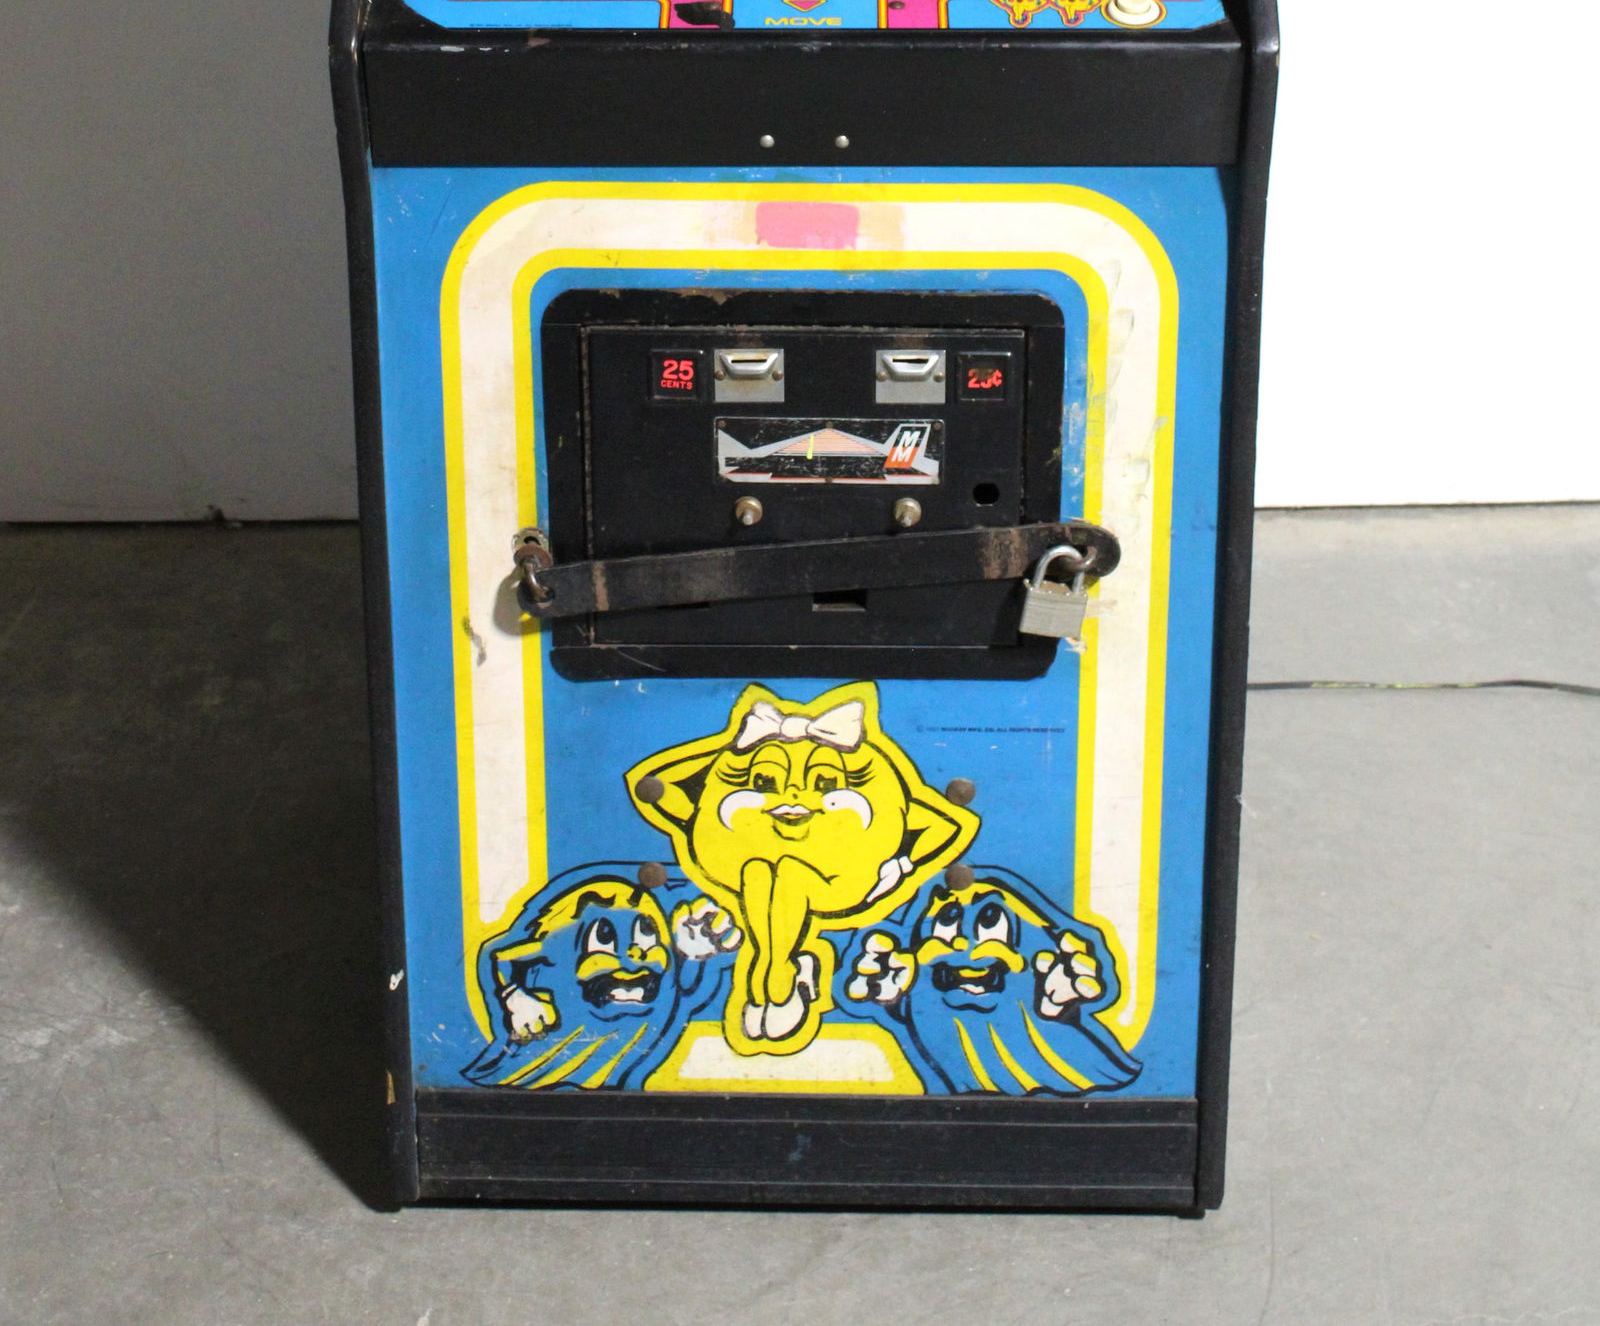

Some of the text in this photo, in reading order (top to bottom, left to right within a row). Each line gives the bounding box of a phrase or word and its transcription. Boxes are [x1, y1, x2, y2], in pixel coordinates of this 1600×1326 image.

[764, 17, 842, 26] MOVE
[662, 359, 694, 381] 25
[660, 379, 693, 390] CENTS
